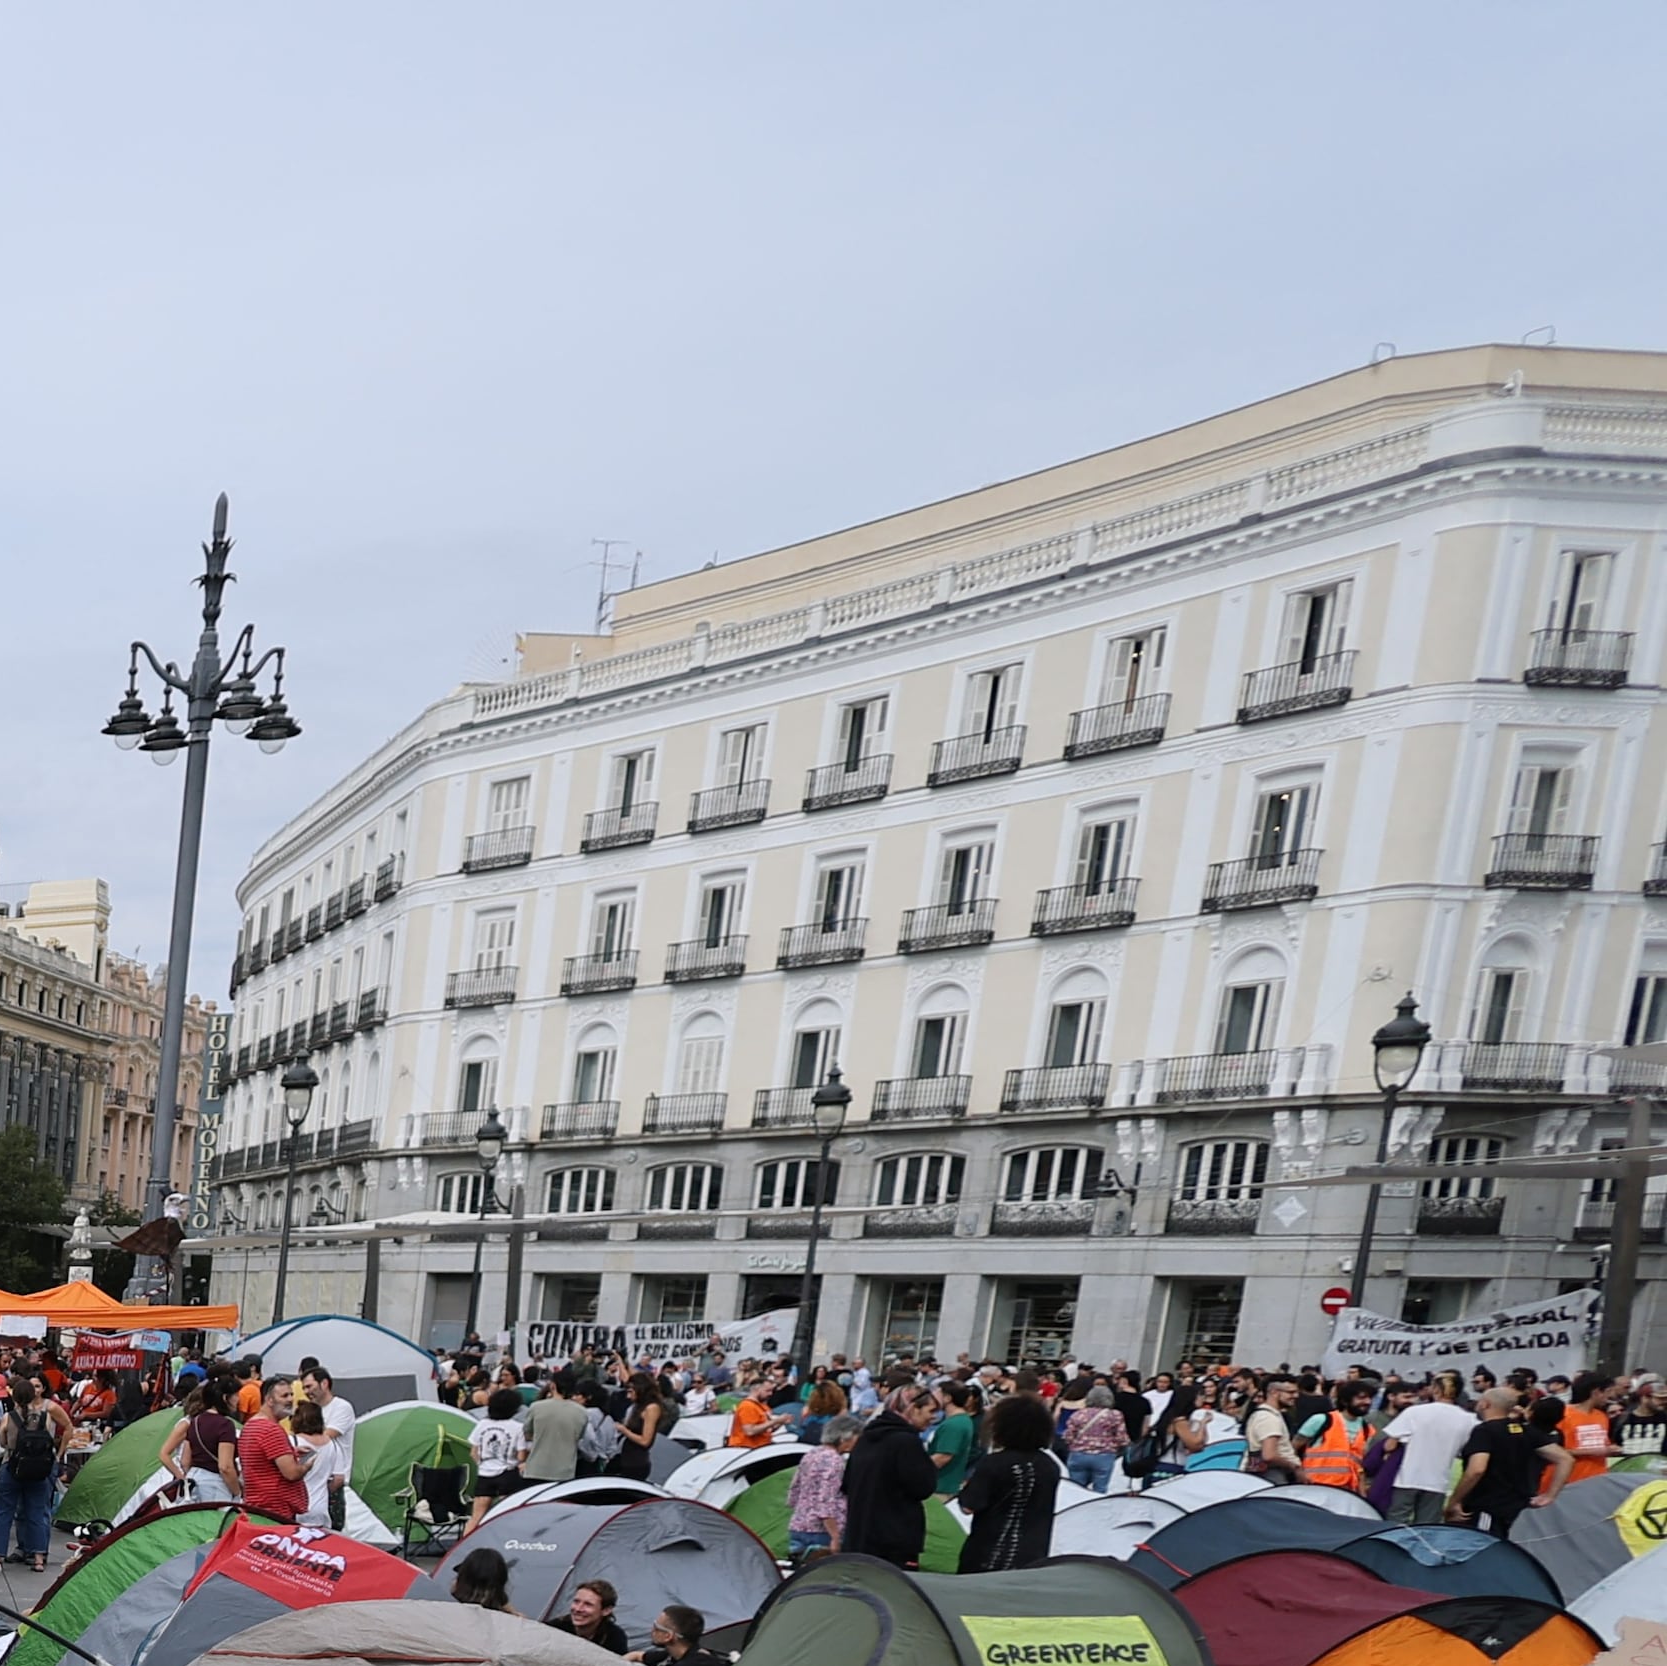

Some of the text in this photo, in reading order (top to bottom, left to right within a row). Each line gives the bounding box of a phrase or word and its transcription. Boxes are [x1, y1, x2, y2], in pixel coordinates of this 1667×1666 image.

[192, 1016, 228, 1229] HOTEL MODERNO
[528, 1323, 627, 1358] CONTRA
[635, 1325, 645, 1340] EL
[632, 1344, 641, 1359] Y
[646, 1343, 669, 1359] SUS
[1337, 1338, 1411, 1356] GRATUITA
[1478, 1331, 1570, 1352] CALIDA
[250, 1534, 347, 1571] ONTRA
[504, 1539, 557, 1552] Quechua
[249, 1541, 344, 1582] ORRIENTE
[986, 1642, 1151, 1666] GREENPEACE
